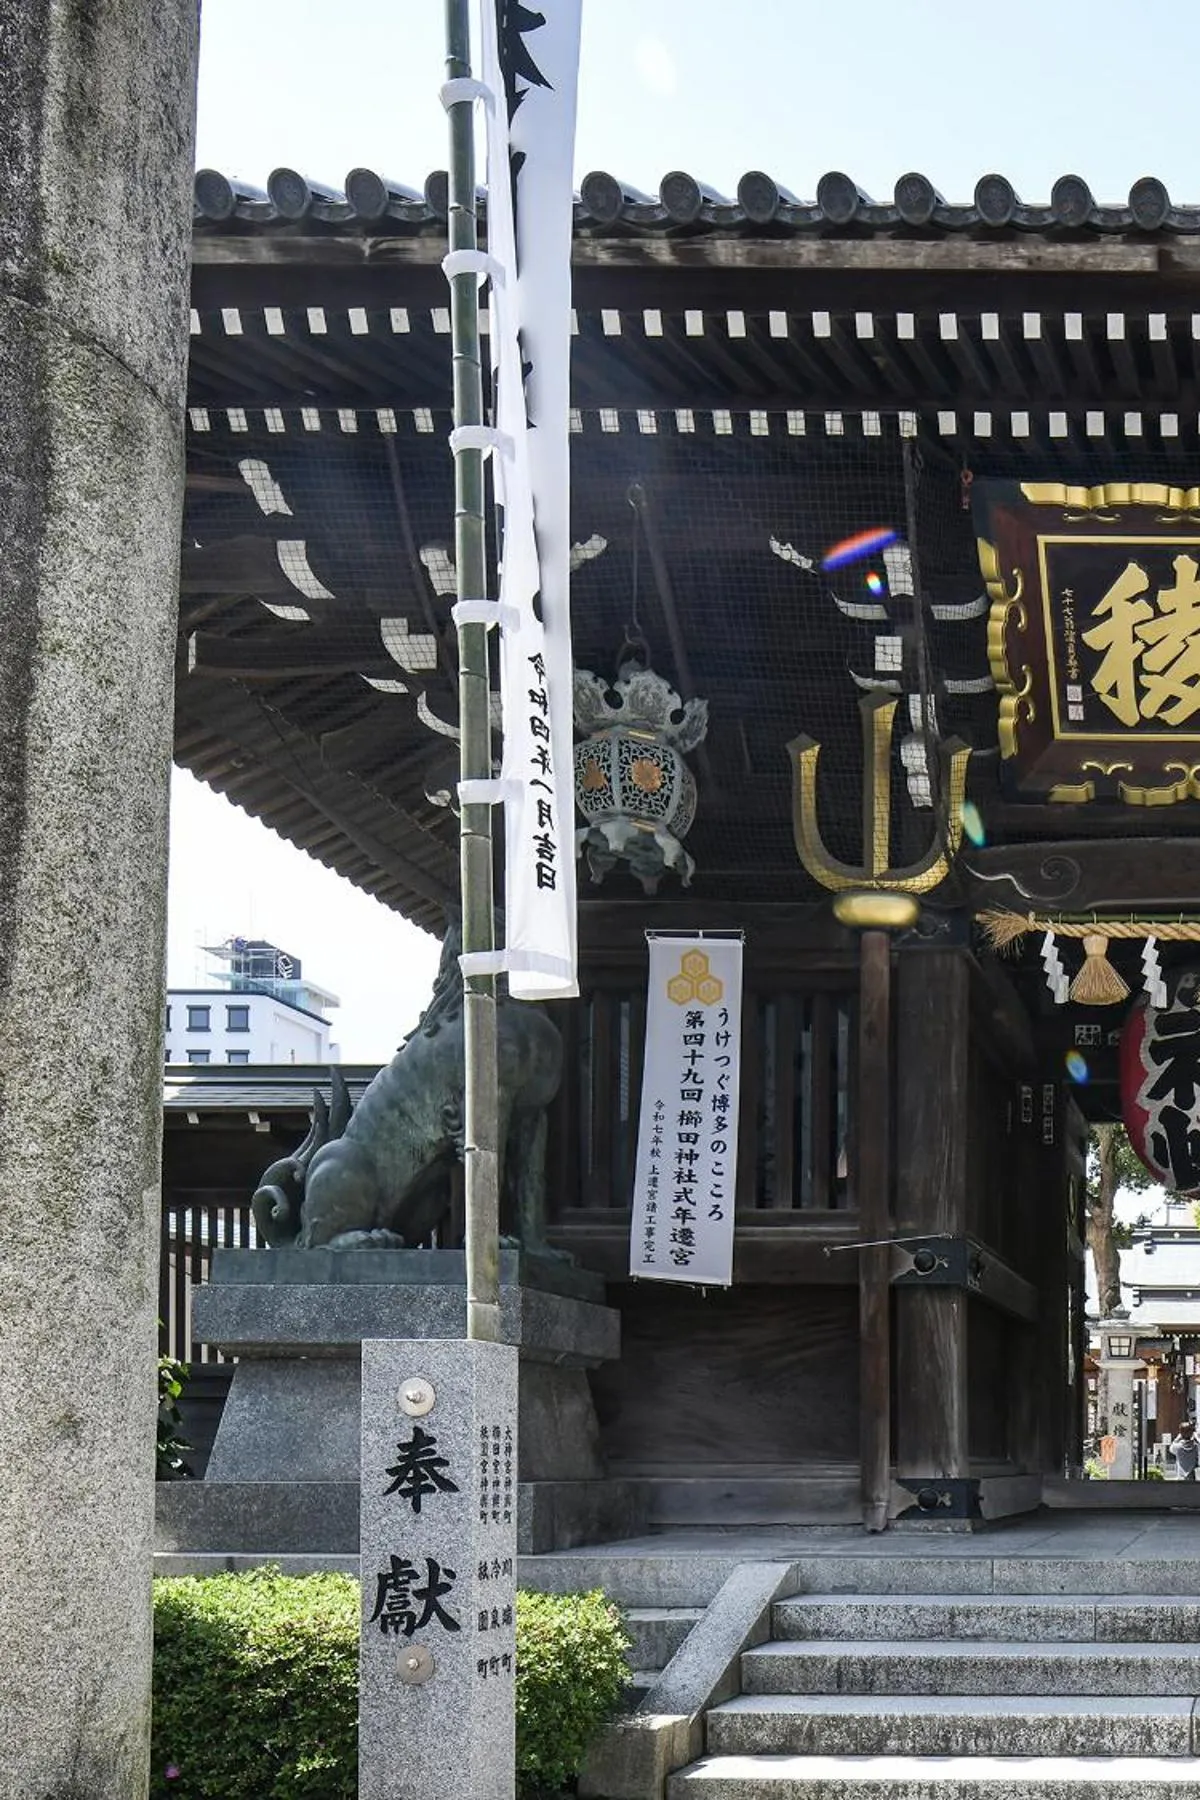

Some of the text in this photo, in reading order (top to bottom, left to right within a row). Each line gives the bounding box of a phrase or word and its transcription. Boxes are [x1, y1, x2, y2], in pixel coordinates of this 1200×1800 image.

[680, 1010, 704, 1103] 第四十九回
[707, 1008, 732, 1222] うけつぐ博多のこころ
